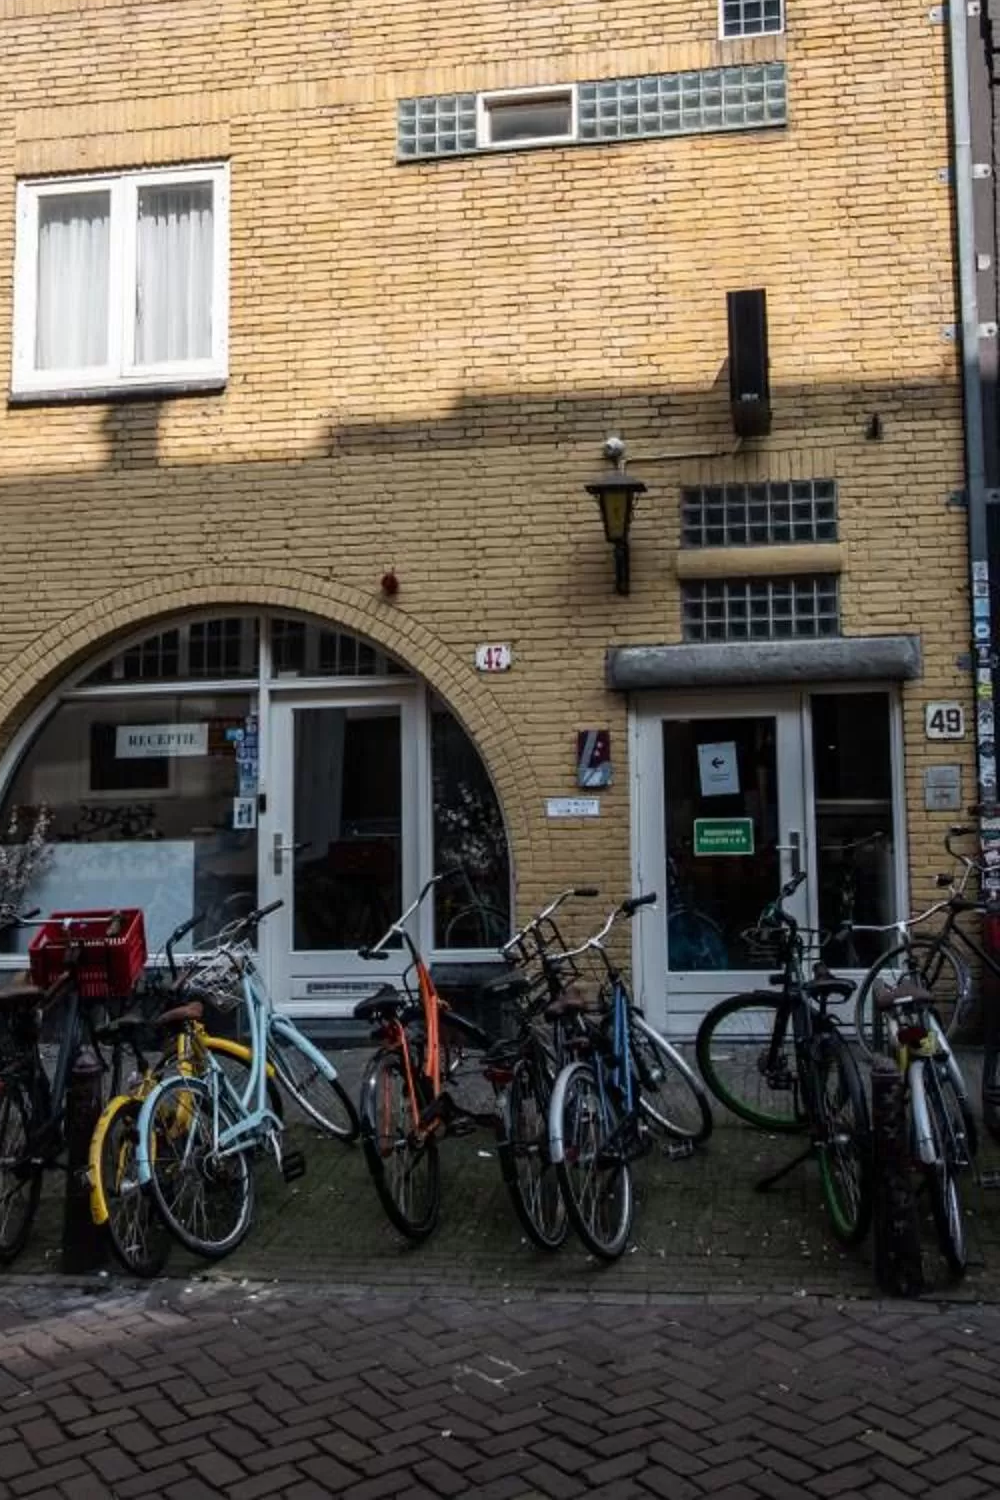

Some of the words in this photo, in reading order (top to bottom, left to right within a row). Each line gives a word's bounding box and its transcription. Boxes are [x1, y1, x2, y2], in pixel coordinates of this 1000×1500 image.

[484, 647, 503, 669] 47
[929, 708, 961, 733] 49
[128, 732, 198, 747] RECEPTIE
